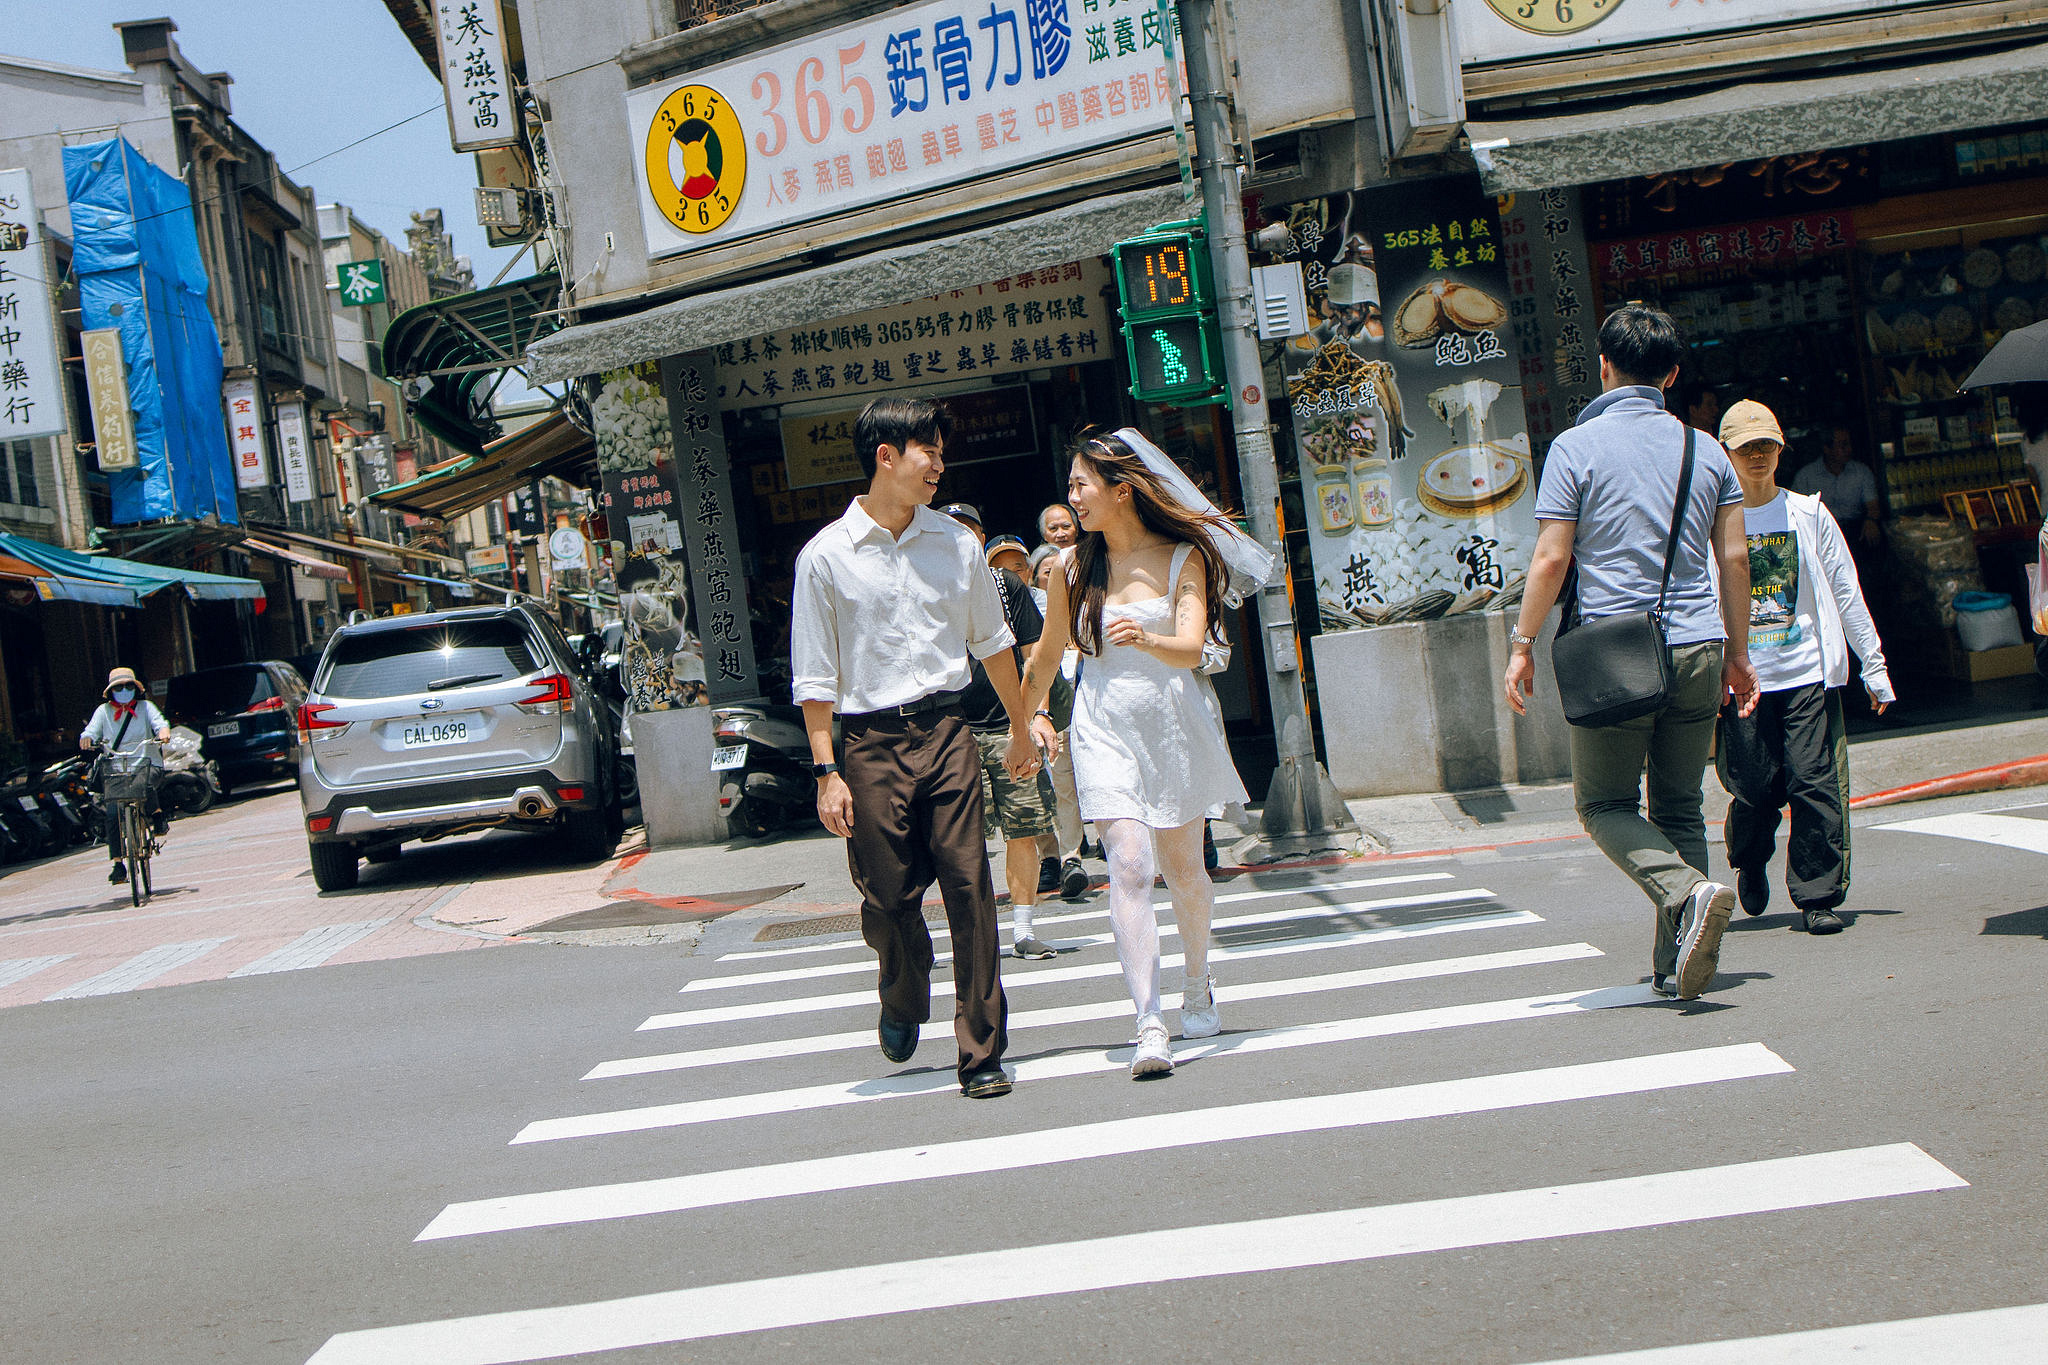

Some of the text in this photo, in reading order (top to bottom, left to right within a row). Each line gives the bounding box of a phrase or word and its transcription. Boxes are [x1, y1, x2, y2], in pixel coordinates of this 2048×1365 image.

[751, 0, 1071, 157] 365 鈣骨力膠
[661, 92, 718, 132] 365
[814, 154, 853, 194] 燕窩
[866, 138, 908, 179] 鮑翅
[921, 123, 962, 166] 蟲草
[976, 107, 1021, 150] 靈芝
[675, 187, 729, 225] 365
[1384, 217, 1490, 249] 365法自然
[343, 266, 381, 302] 茶
[1145, 246, 1189, 304] 19
[791, 364, 835, 392] 燕窩
[842, 358, 896, 385] 鮑翅
[903, 349, 948, 379] 靈芝
[957, 341, 1000, 371] 蟲草
[1436, 330, 1506, 366] 鮑魚
[1295, 381, 1378, 418] 冬蟲夏草
[1761, 536, 1786, 547] WHAT
[1751, 584, 1783, 596] AS THE
[1749, 632, 1789, 644] UESTION?
